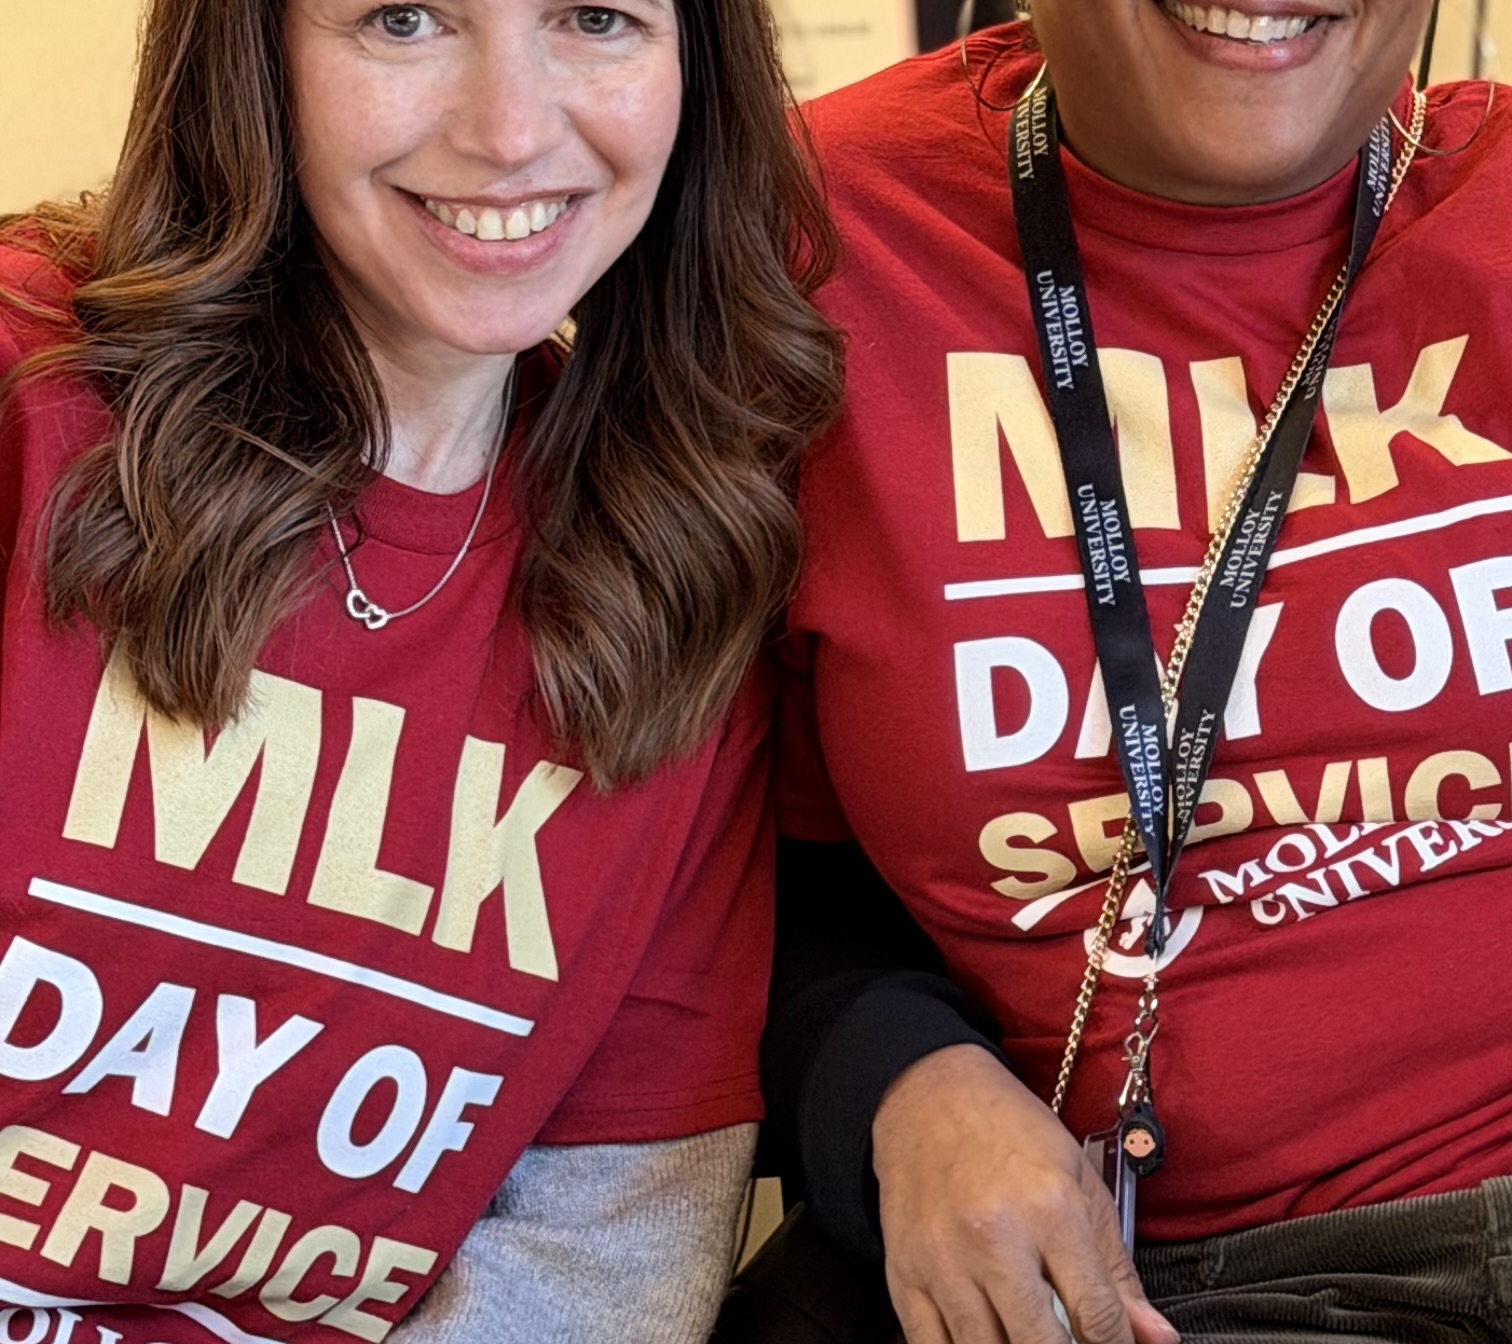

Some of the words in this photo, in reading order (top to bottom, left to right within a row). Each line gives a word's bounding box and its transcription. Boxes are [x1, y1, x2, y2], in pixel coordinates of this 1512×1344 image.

[1016, 98, 1034, 179] IVERSITY
[1036, 269, 1074, 391] UNIVERSITY
[1059, 284, 1089, 368] MOLLOY
[1077, 483, 1116, 608] UNIVERSITY
[1100, 498, 1131, 584] MOLLOY
[1218, 507, 1260, 589] MOLLOY
[1229, 489, 1284, 610] UNIVERSITY
[61, 660, 584, 983] MLK
[1119, 704, 1157, 838] UNIVERSITY
[1140, 723, 1165, 817] MOLLOY
[1175, 726, 1195, 821] MOLLOY
[0, 935, 325, 1140] DAY
[316, 1044, 505, 1194] OF
[0, 1124, 439, 1344] ERVICE
